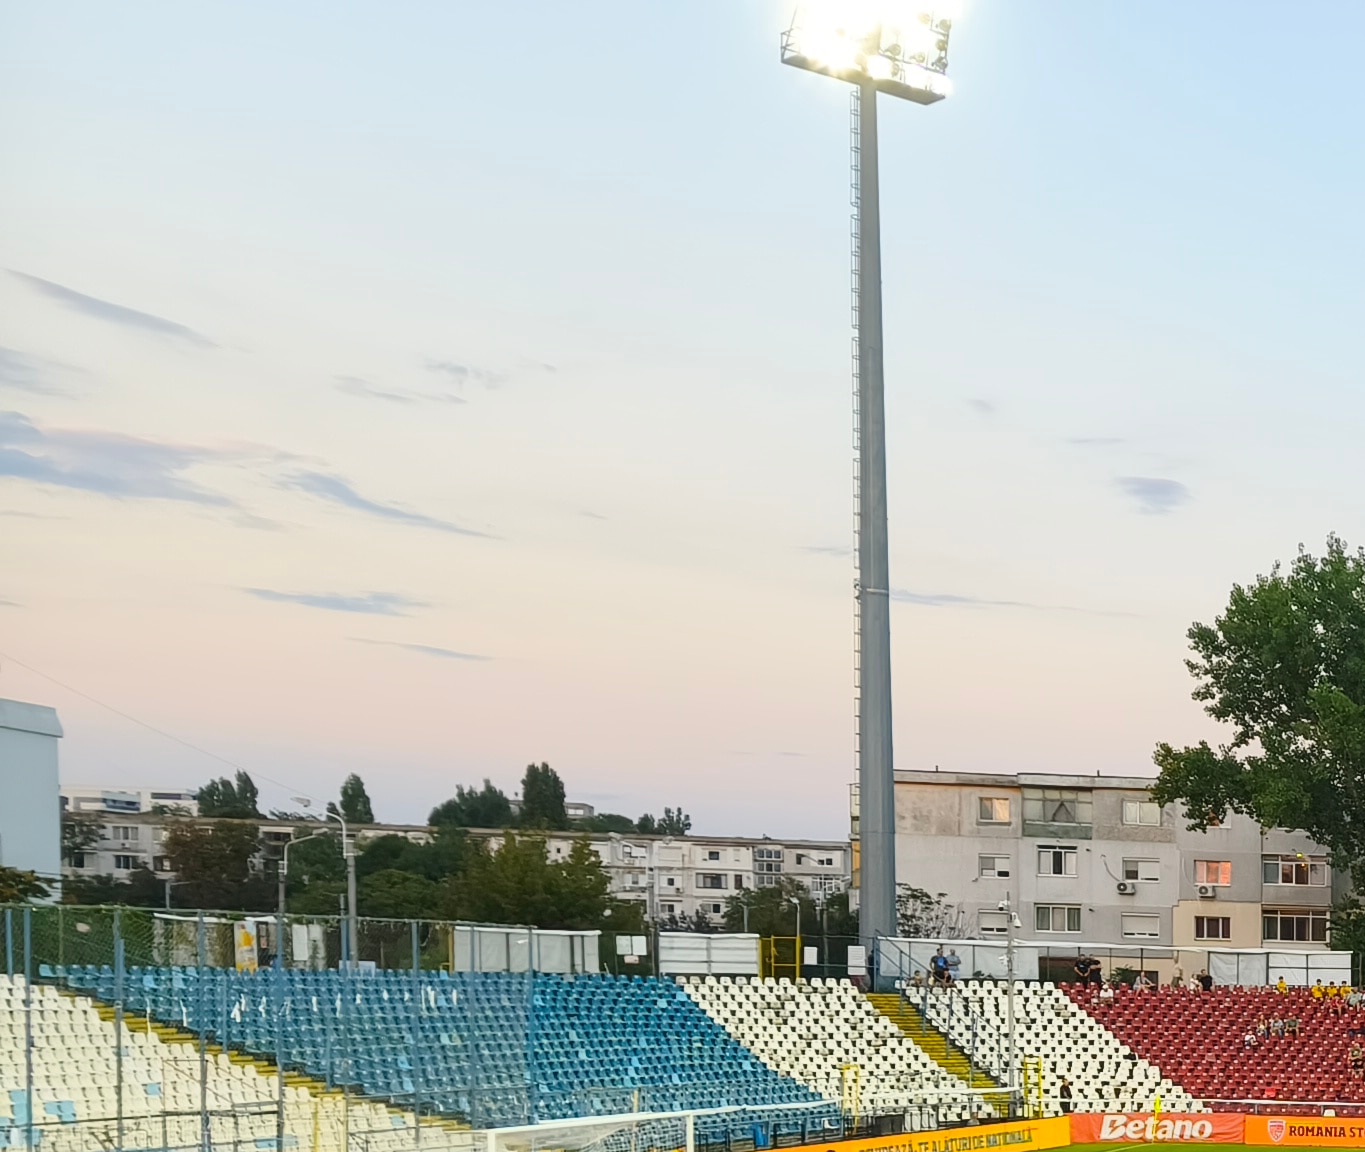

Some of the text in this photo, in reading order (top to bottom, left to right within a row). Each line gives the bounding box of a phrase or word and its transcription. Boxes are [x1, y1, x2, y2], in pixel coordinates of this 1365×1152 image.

[1100, 1114, 1213, 1141] Betano
[1289, 1125, 1346, 1138] ROMANIA
[973, 1135, 984, 1150] DE
